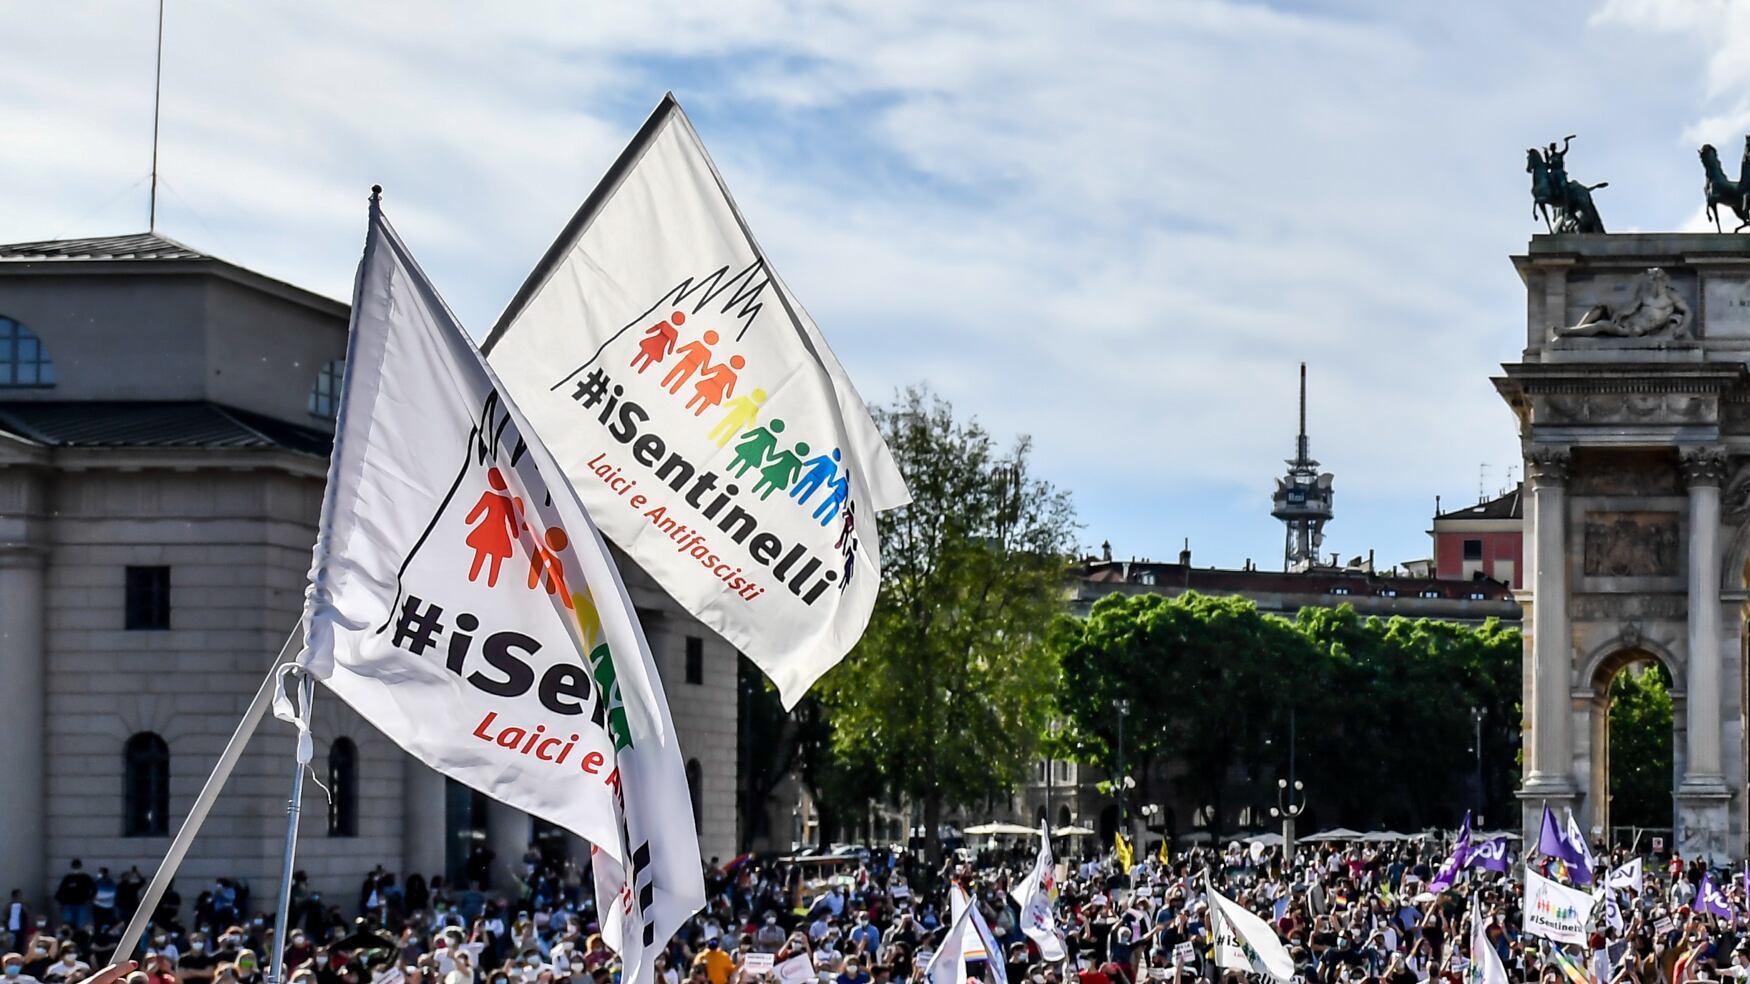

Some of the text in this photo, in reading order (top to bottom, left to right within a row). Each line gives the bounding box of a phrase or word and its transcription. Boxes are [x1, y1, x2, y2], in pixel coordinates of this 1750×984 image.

[571, 366, 838, 607] #iSentinelli
[587, 453, 765, 603] Laici e Antifascisti
[473, 711, 607, 776] Laici e
